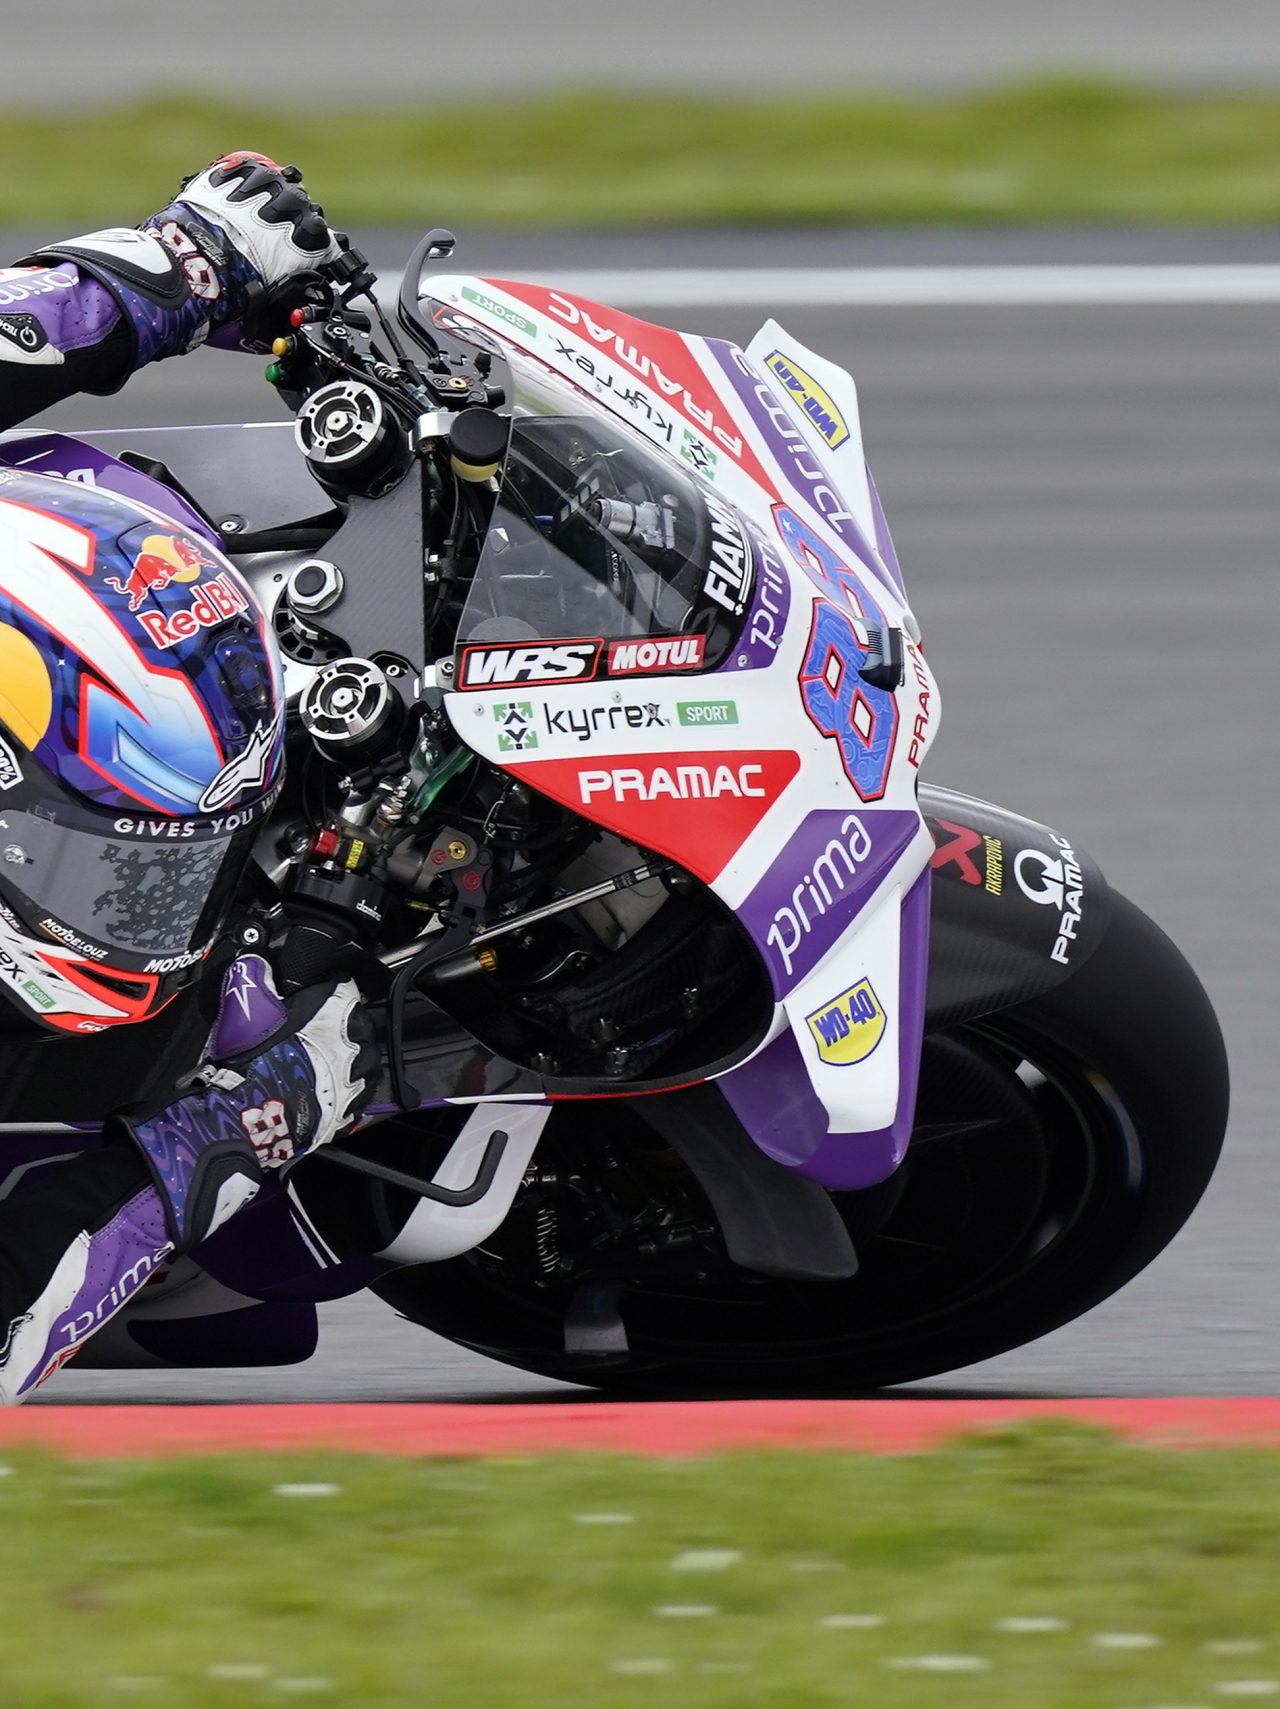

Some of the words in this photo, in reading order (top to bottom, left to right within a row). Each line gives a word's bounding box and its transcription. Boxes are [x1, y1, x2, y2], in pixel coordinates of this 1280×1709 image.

[472, 294, 527, 330] SPORT
[548, 291, 744, 459] PRAMAC
[553, 338, 674, 443] kyrrex
[137, 586, 222, 650] Red
[467, 645, 595, 685] WRS
[612, 639, 700, 671] MOTUL
[544, 702, 665, 742] kyrrex
[686, 705, 729, 722] SPORT
[577, 765, 766, 804] PRAMAC
[113, 818, 196, 839] GIVES
[209, 808, 254, 835] YOU
[766, 814, 872, 976] prima
[1050, 833, 1084, 965] PRAMAC
[28, 984, 51, 1007] SPORT
[814, 988, 877, 1048] WD-40
